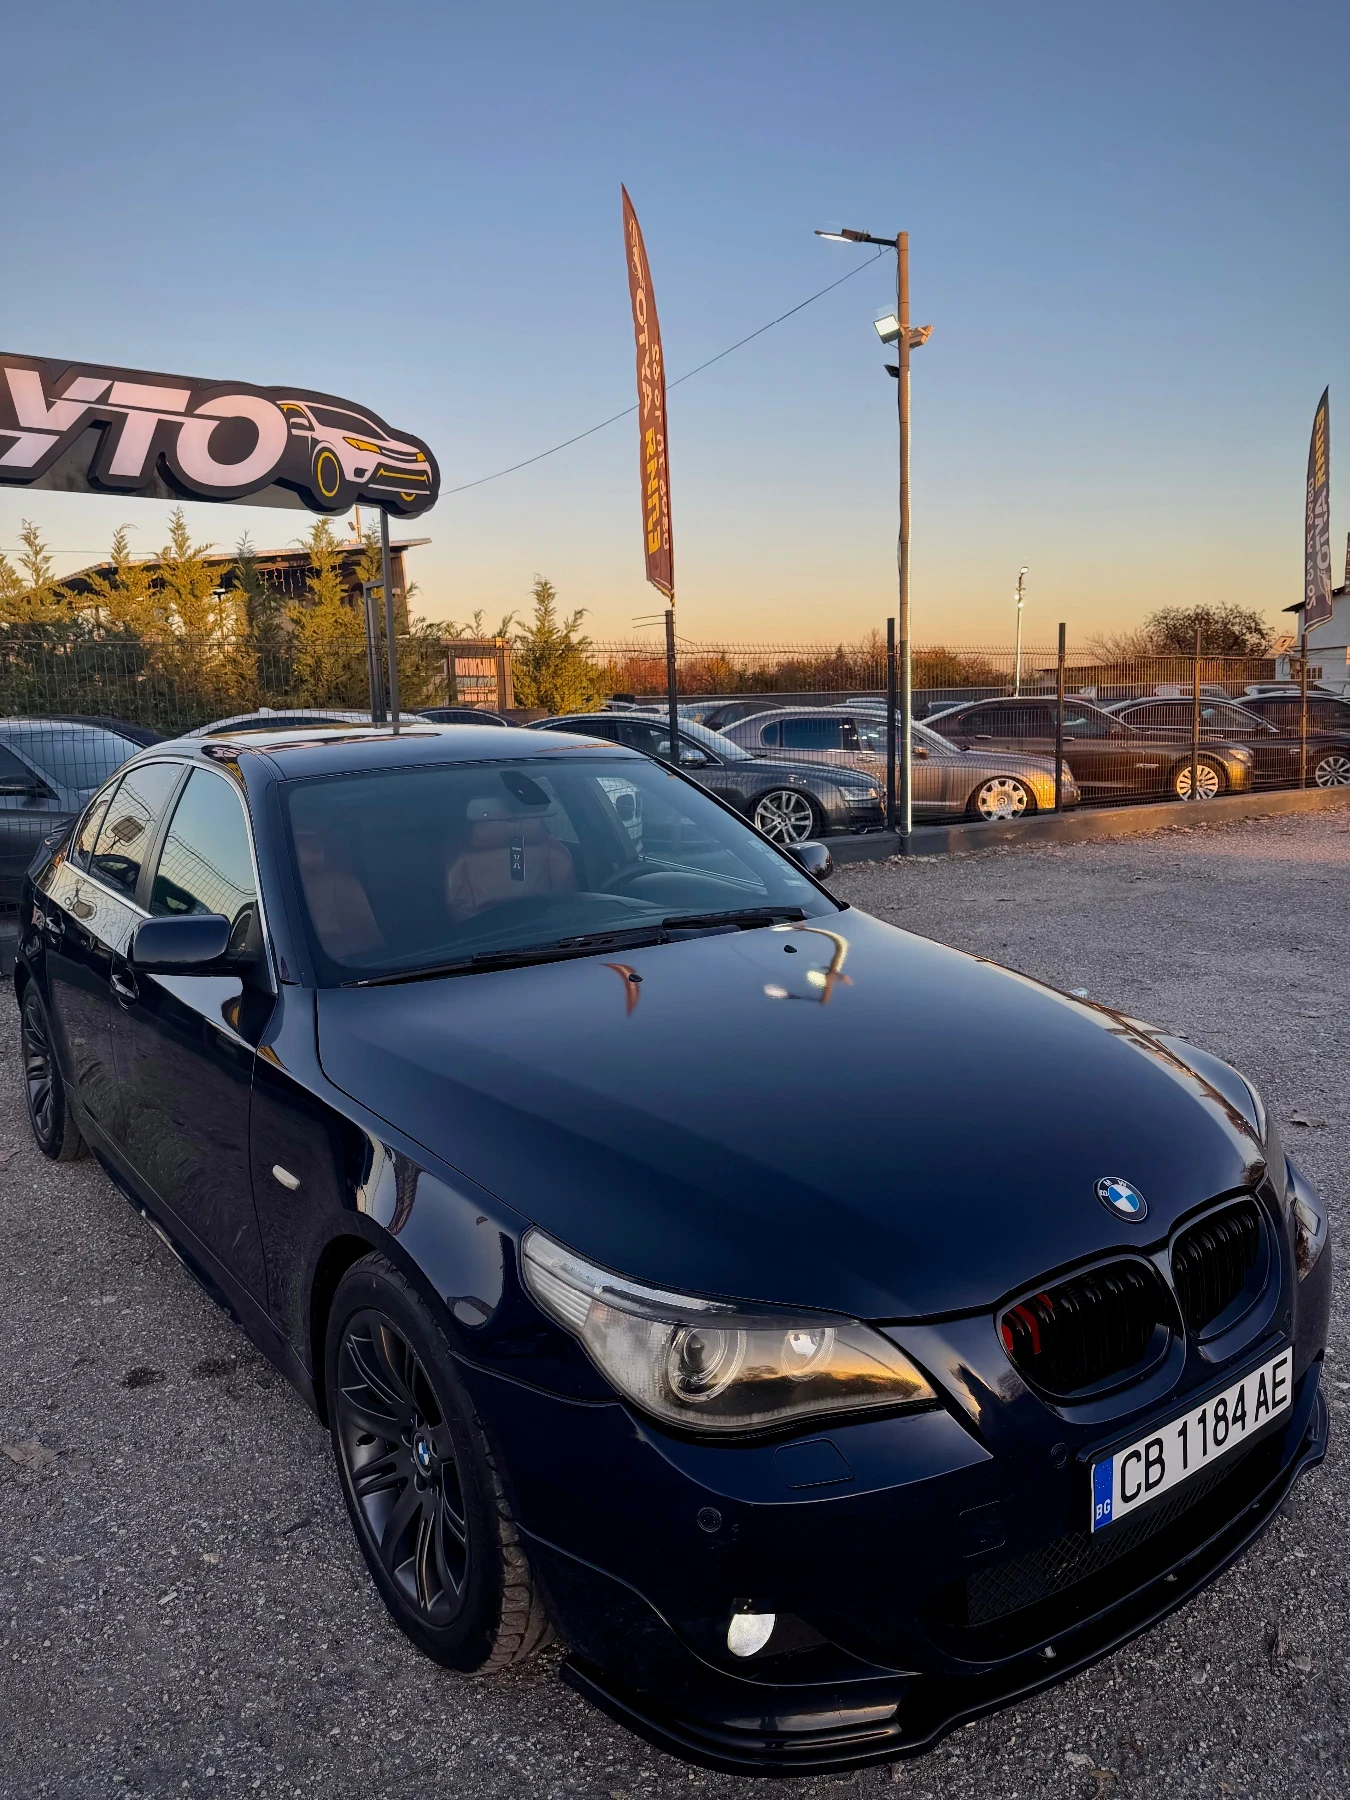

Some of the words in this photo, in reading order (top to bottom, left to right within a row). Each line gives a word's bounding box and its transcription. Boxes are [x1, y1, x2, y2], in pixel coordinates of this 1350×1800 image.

[1120, 1437, 1166, 1504] CB
[1177, 1384, 1248, 1470] 1184
[1254, 1356, 1288, 1422] AE
[1095, 1498, 1111, 1520] BG
